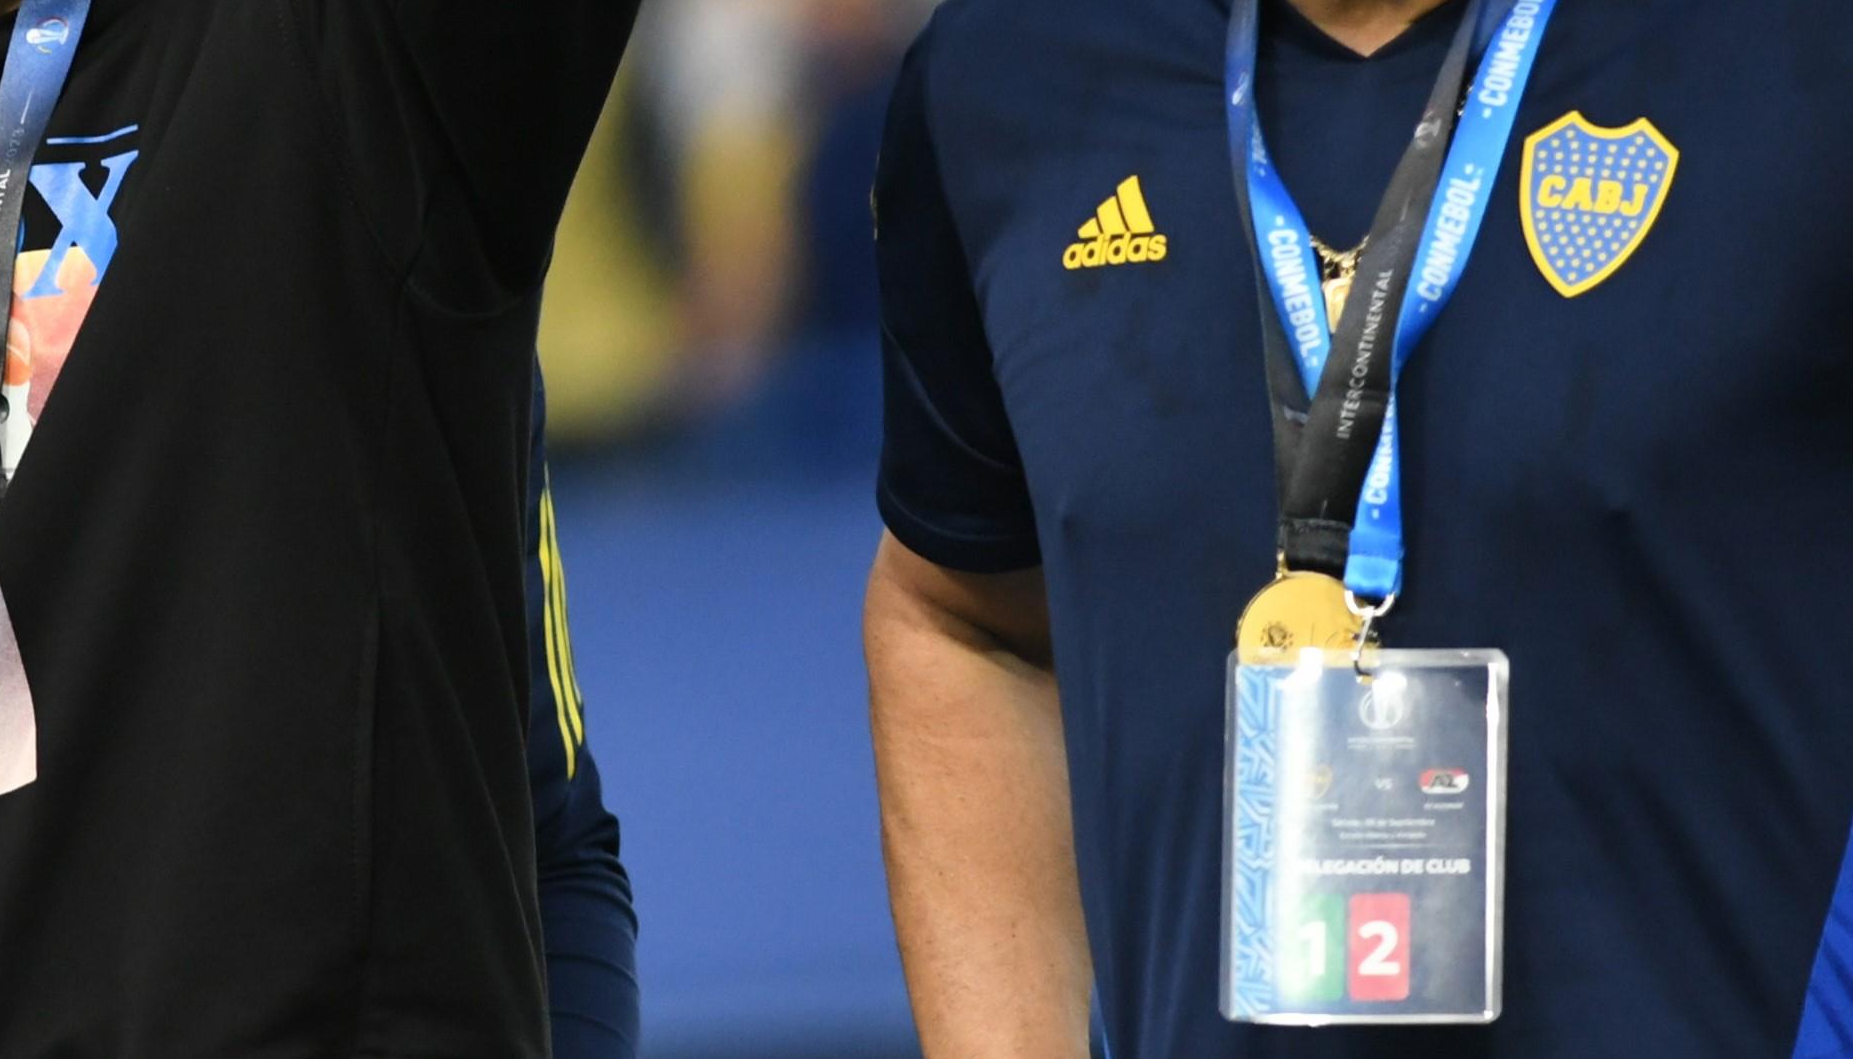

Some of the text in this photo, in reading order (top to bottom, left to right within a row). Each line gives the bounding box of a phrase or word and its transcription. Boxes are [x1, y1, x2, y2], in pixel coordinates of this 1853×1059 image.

[1537, 173, 1647, 217] CABJ
[1062, 231, 1167, 271] adidas
[1417, 172, 1482, 302] CONMEBOL
[1268, 228, 1321, 360] CONMEBOL
[1337, 269, 1393, 439] INTERCONTINENTAL
[1297, 854, 1471, 874] LEGACIÓN DE CLUB
[1300, 921, 1401, 976] 1 2
